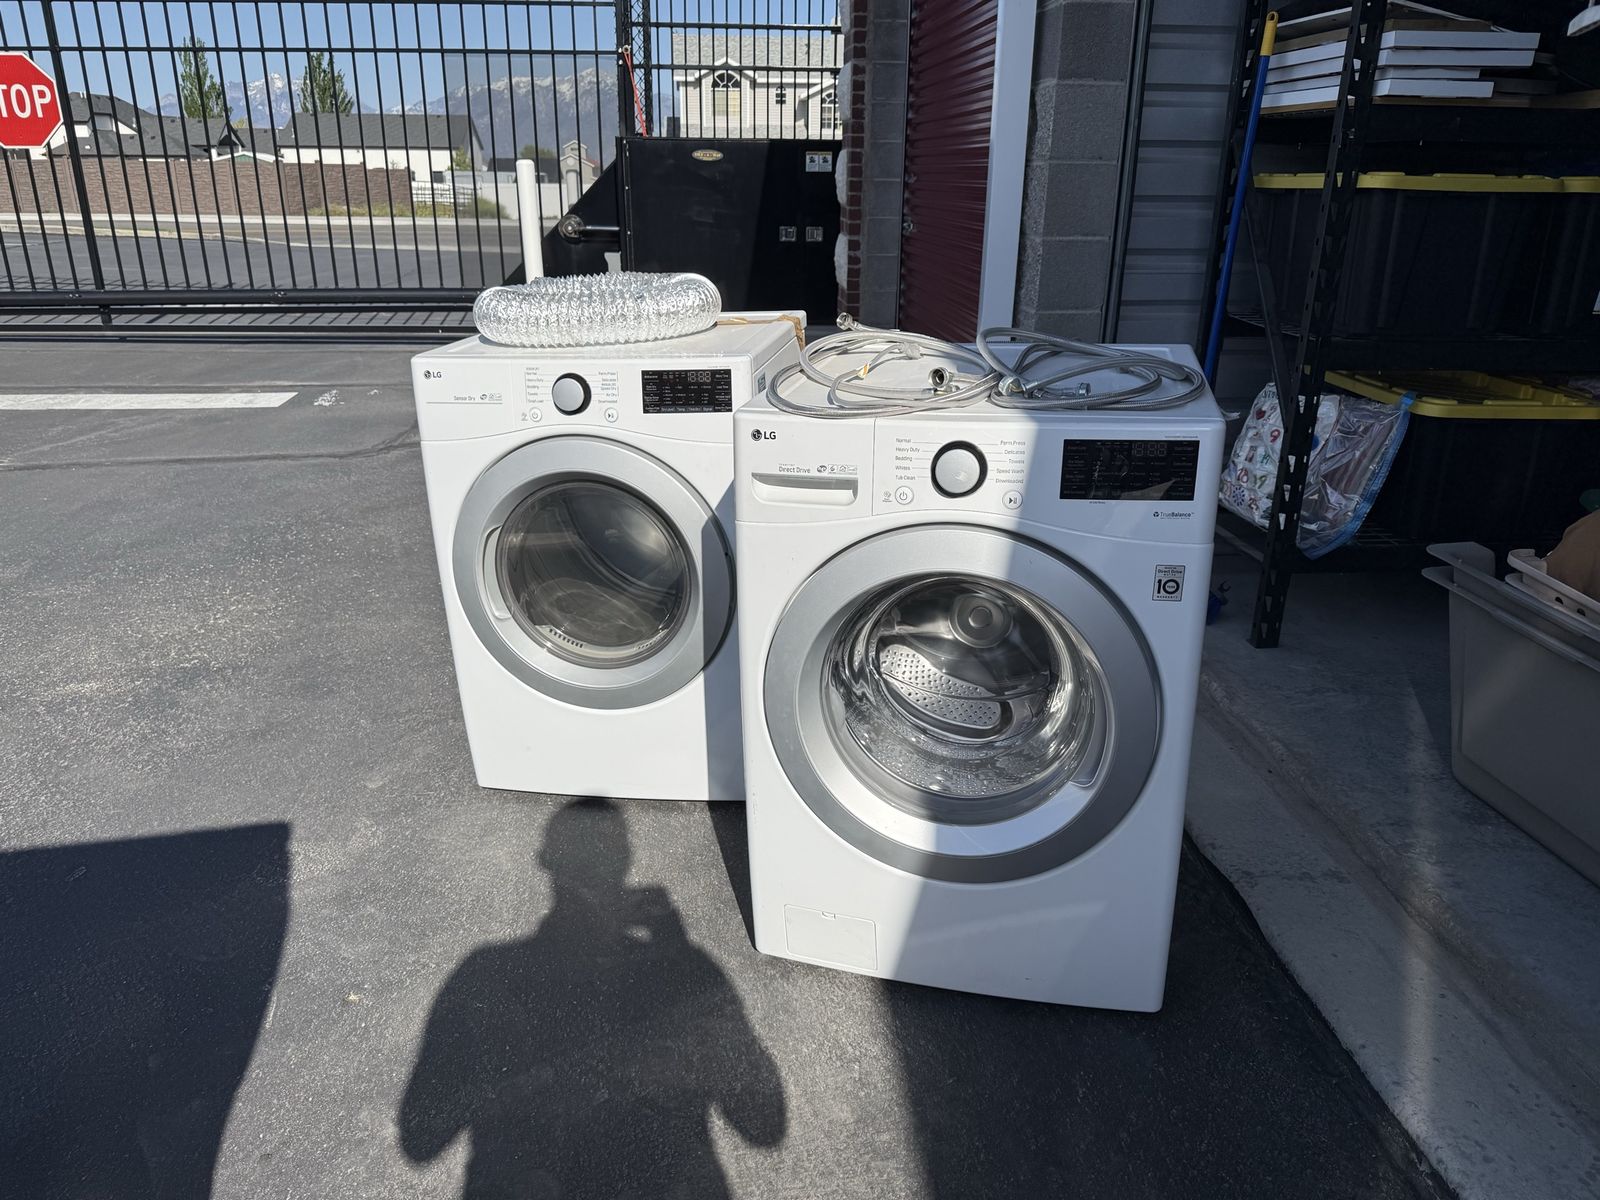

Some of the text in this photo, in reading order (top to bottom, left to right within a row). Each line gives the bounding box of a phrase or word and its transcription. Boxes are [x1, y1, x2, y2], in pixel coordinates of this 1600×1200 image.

[0, 83, 52, 118] TOP
[764, 431, 776, 440] LG
[1270, 428, 1280, 443] 9
[1156, 579, 1180, 595] 10
